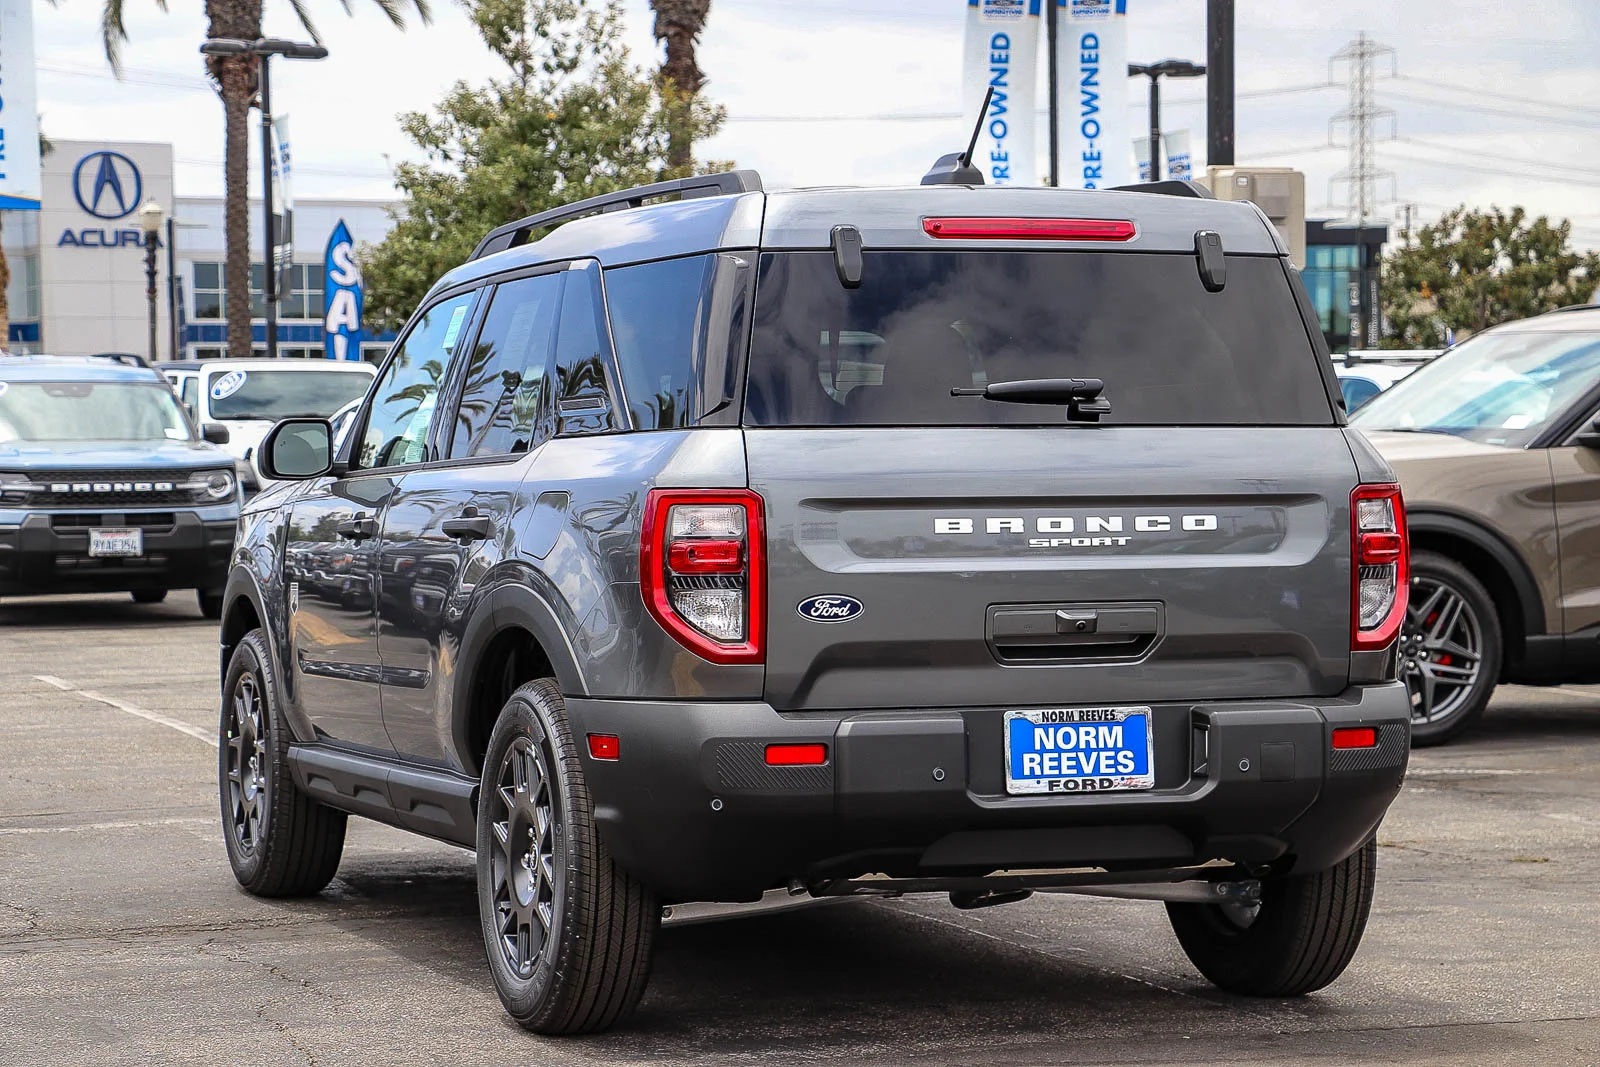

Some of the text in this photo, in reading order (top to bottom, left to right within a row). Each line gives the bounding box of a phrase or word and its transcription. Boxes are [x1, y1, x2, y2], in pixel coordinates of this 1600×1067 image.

[989, 32, 1011, 184] RE-OWNED
[51, 482, 173, 493] BRONCO
[934, 515, 1218, 534] BRONCO
[1029, 536, 1132, 548] SPORT
[810, 599, 852, 617] Ford
[1041, 709, 1116, 723] NORM REEVES
[1033, 725, 1124, 750] NORM
[1022, 750, 1135, 776] REEVES
[1047, 777, 1115, 791] FORD
